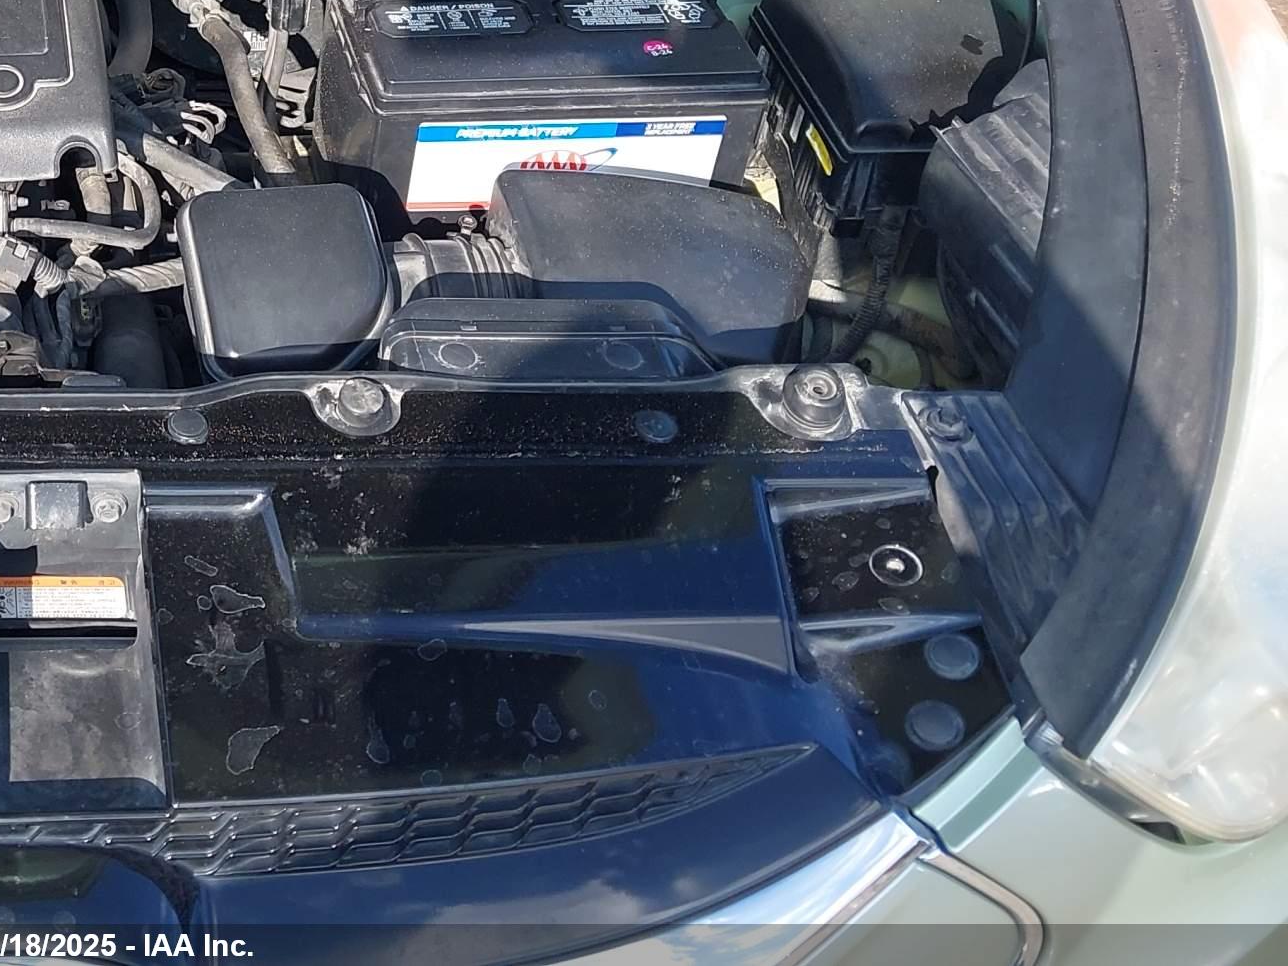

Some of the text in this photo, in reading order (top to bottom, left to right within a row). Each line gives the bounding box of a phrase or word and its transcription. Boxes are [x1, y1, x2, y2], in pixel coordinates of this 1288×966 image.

[410, 4, 446, 12] DANGER
[458, 2, 495, 10] POISON
[455, 126, 579, 139] PREMIUM BATTERY
